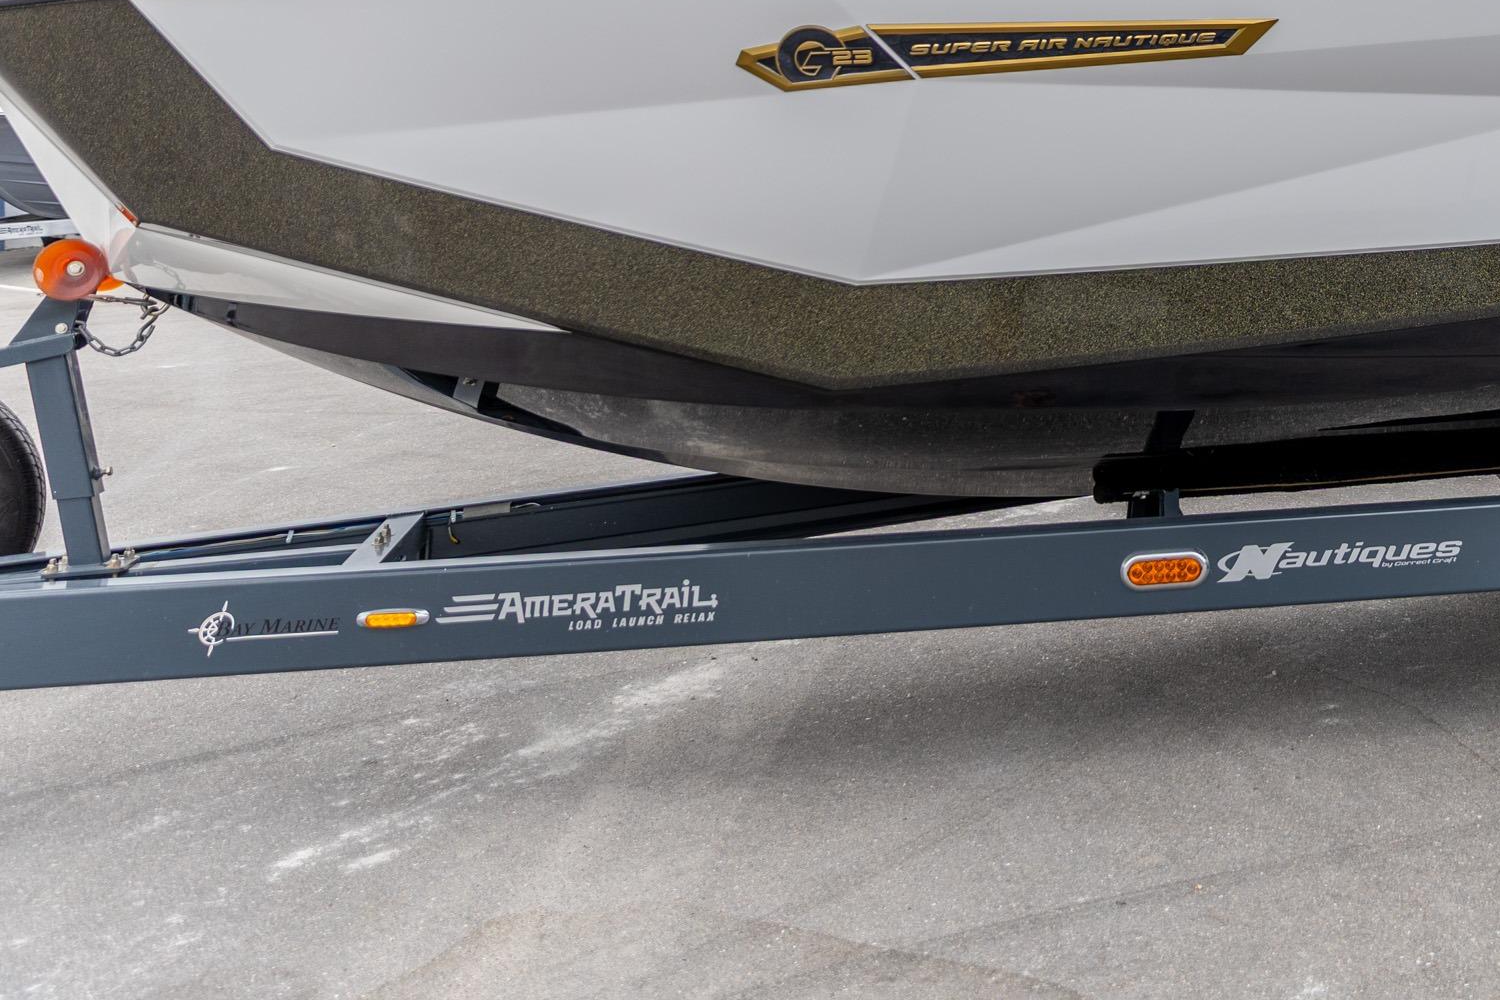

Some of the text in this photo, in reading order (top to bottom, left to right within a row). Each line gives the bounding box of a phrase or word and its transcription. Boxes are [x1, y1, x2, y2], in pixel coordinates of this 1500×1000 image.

[909, 40, 1012, 56] SUPER
[1017, 38, 1068, 51] AIR
[1073, 32, 1217, 49] NAUTIQUE
[1216, 540, 1463, 583] Nautiques
[497, 579, 719, 624] AMERATRAIL
[215, 617, 340, 638] BAY MARINE
[568, 611, 716, 631] LOAD LAUNCH RELAX
